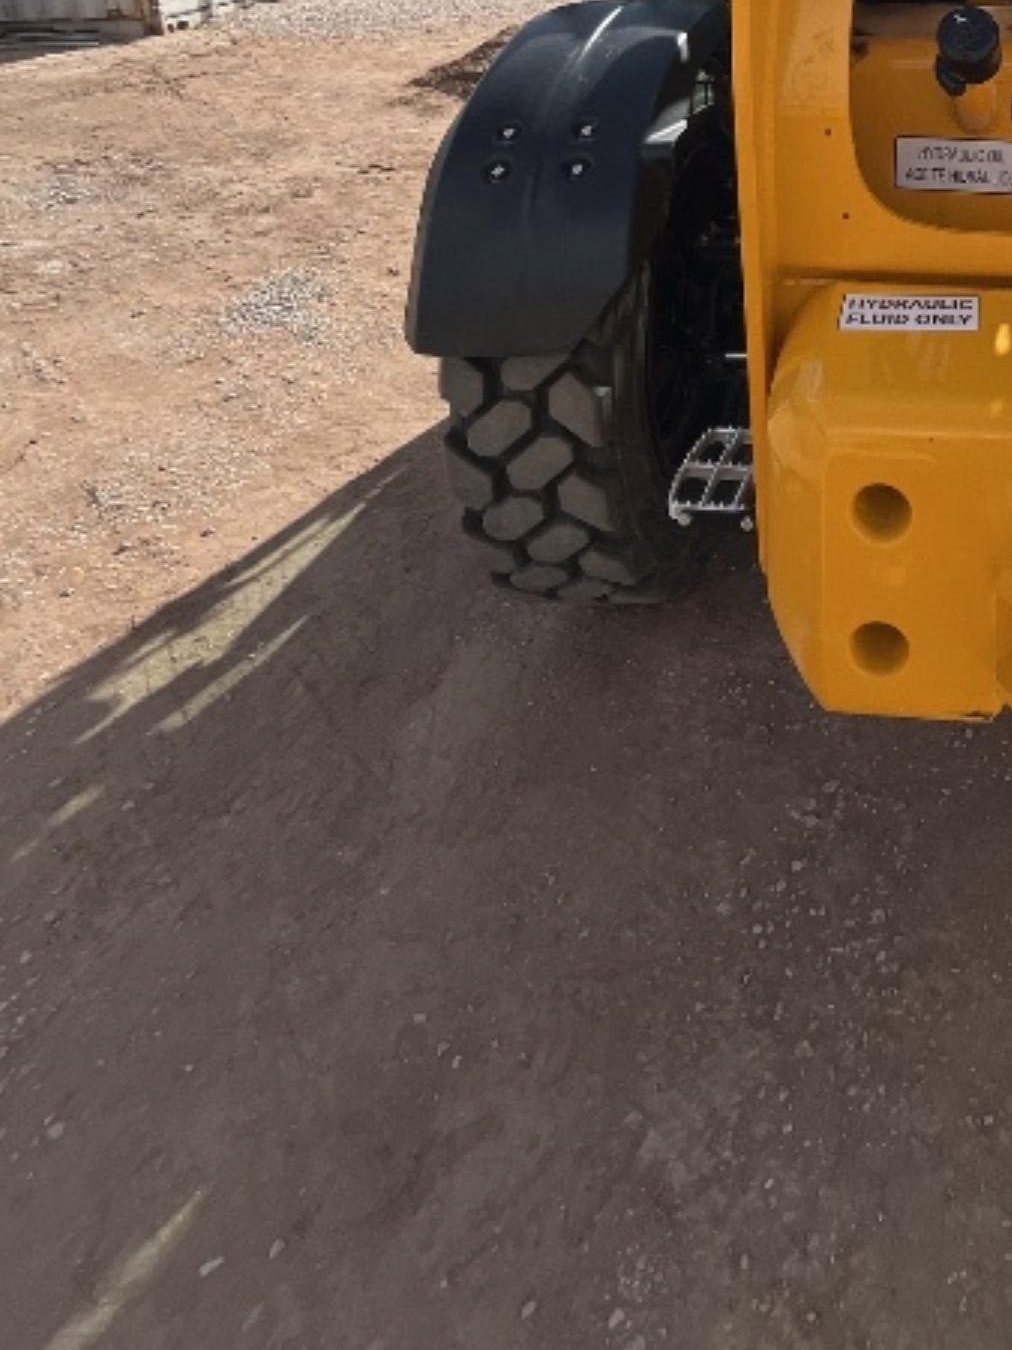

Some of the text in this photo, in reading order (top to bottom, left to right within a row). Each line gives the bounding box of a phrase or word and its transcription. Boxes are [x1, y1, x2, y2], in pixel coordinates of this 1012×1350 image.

[848, 298, 973, 310] HYDRAULIC
[845, 313, 973, 325] FLUID ONLY
